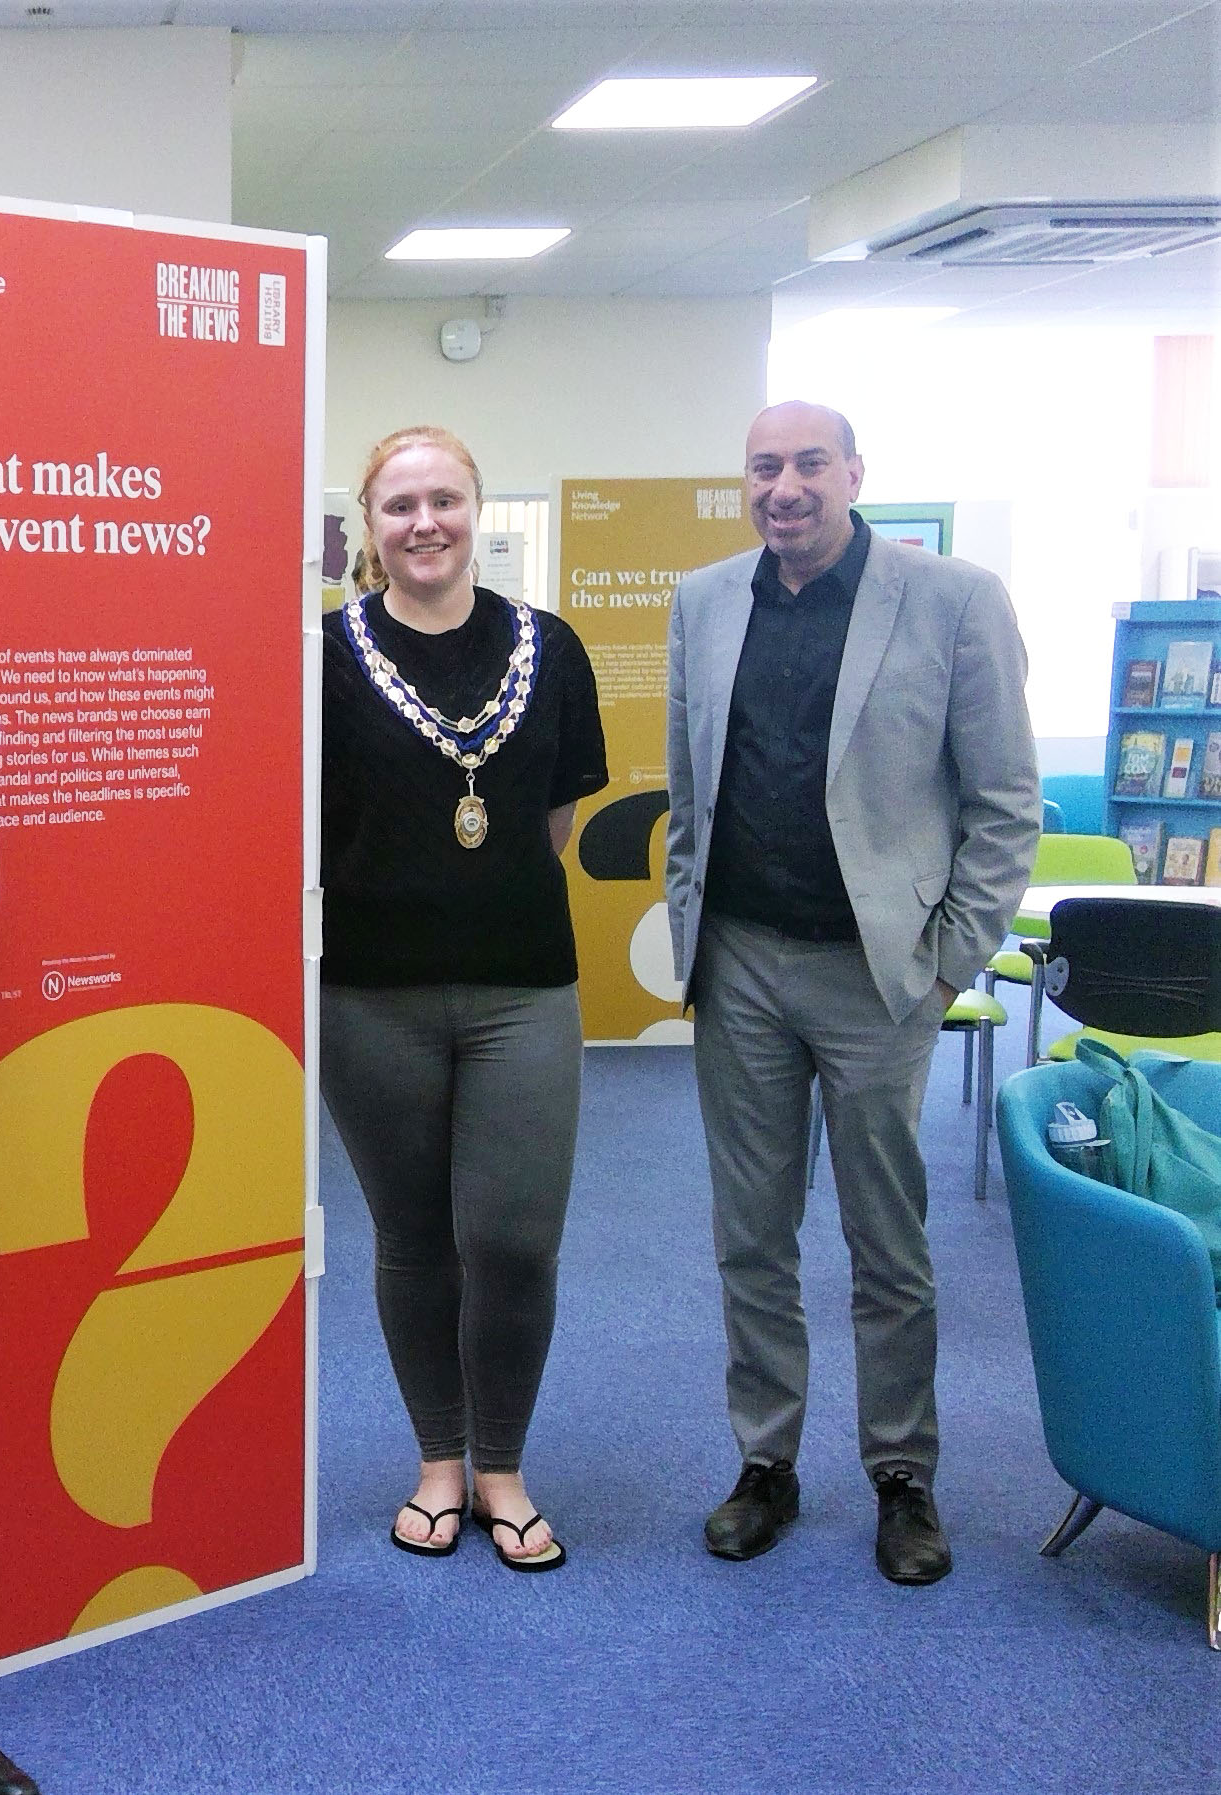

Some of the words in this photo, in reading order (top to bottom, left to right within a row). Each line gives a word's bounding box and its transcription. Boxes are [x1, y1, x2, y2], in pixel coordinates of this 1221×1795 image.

[156, 262, 239, 304] BREAKING
[264, 286, 272, 340] BRITISH
[272, 280, 281, 335] LIBRARY
[157, 302, 187, 338] THE
[192, 306, 239, 344] NEWS
[32, 453, 162, 499] makes
[572, 490, 599, 501] Living
[696, 489, 741, 505] BREAKING
[571, 511, 608, 521] Network
[572, 501, 620, 512] Knowledge
[697, 504, 713, 519] THE
[715, 504, 741, 519] NEWS
[94, 515, 212, 556] news?
[571, 568, 611, 586] Can
[616, 570, 646, 585] we
[571, 589, 605, 608] the
[609, 589, 671, 608] news?
[14, 649, 55, 663] events
[58, 648, 86, 663] have
[90, 648, 129, 665] always
[132, 647, 192, 661] dominated
[0, 669, 21, 684] We
[24, 669, 54, 683] need
[58, 669, 71, 683] to
[73, 668, 105, 682] know
[108, 667, 145, 682] what's
[147, 666, 207, 684] happening
[34, 692, 51, 705] us,
[54, 688, 77, 703] and
[80, 688, 105, 702] how
[108, 688, 140, 701] these
[143, 687, 181, 701] events
[183, 685, 214, 702] might
[15, 709, 39, 724] The
[42, 711, 74, 724] news
[77, 708, 118, 723] brands
[121, 709, 138, 721] we
[141, 706, 183, 721] choose
[185, 707, 210, 719] earn
[0, 731, 39, 747] finding
[43, 729, 65, 744] and
[68, 728, 113, 745] filtering
[116, 728, 134, 741] the
[138, 726, 165, 740] most
[168, 724, 203, 739] useful
[6, 750, 48, 766] stories
[51, 749, 68, 764] for
[71, 752, 88, 763] us.
[91, 747, 124, 761] While
[127, 746, 169, 760] themes
[172, 744, 199, 758] such
[34, 769, 57, 785] and
[60, 768, 103, 786] politics
[106, 769, 124, 781] are
[128, 764, 180, 780] universal,
[10, 791, 49, 806] makes
[53, 790, 72, 804] the
[75, 786, 131, 803] headlines
[134, 786, 143, 800] is
[146, 782, 191, 800] specific
[23, 810, 46, 825] and
[49, 809, 105, 824] audience.
[48, 977, 59, 995] N
[67, 971, 122, 987] Newsworks
